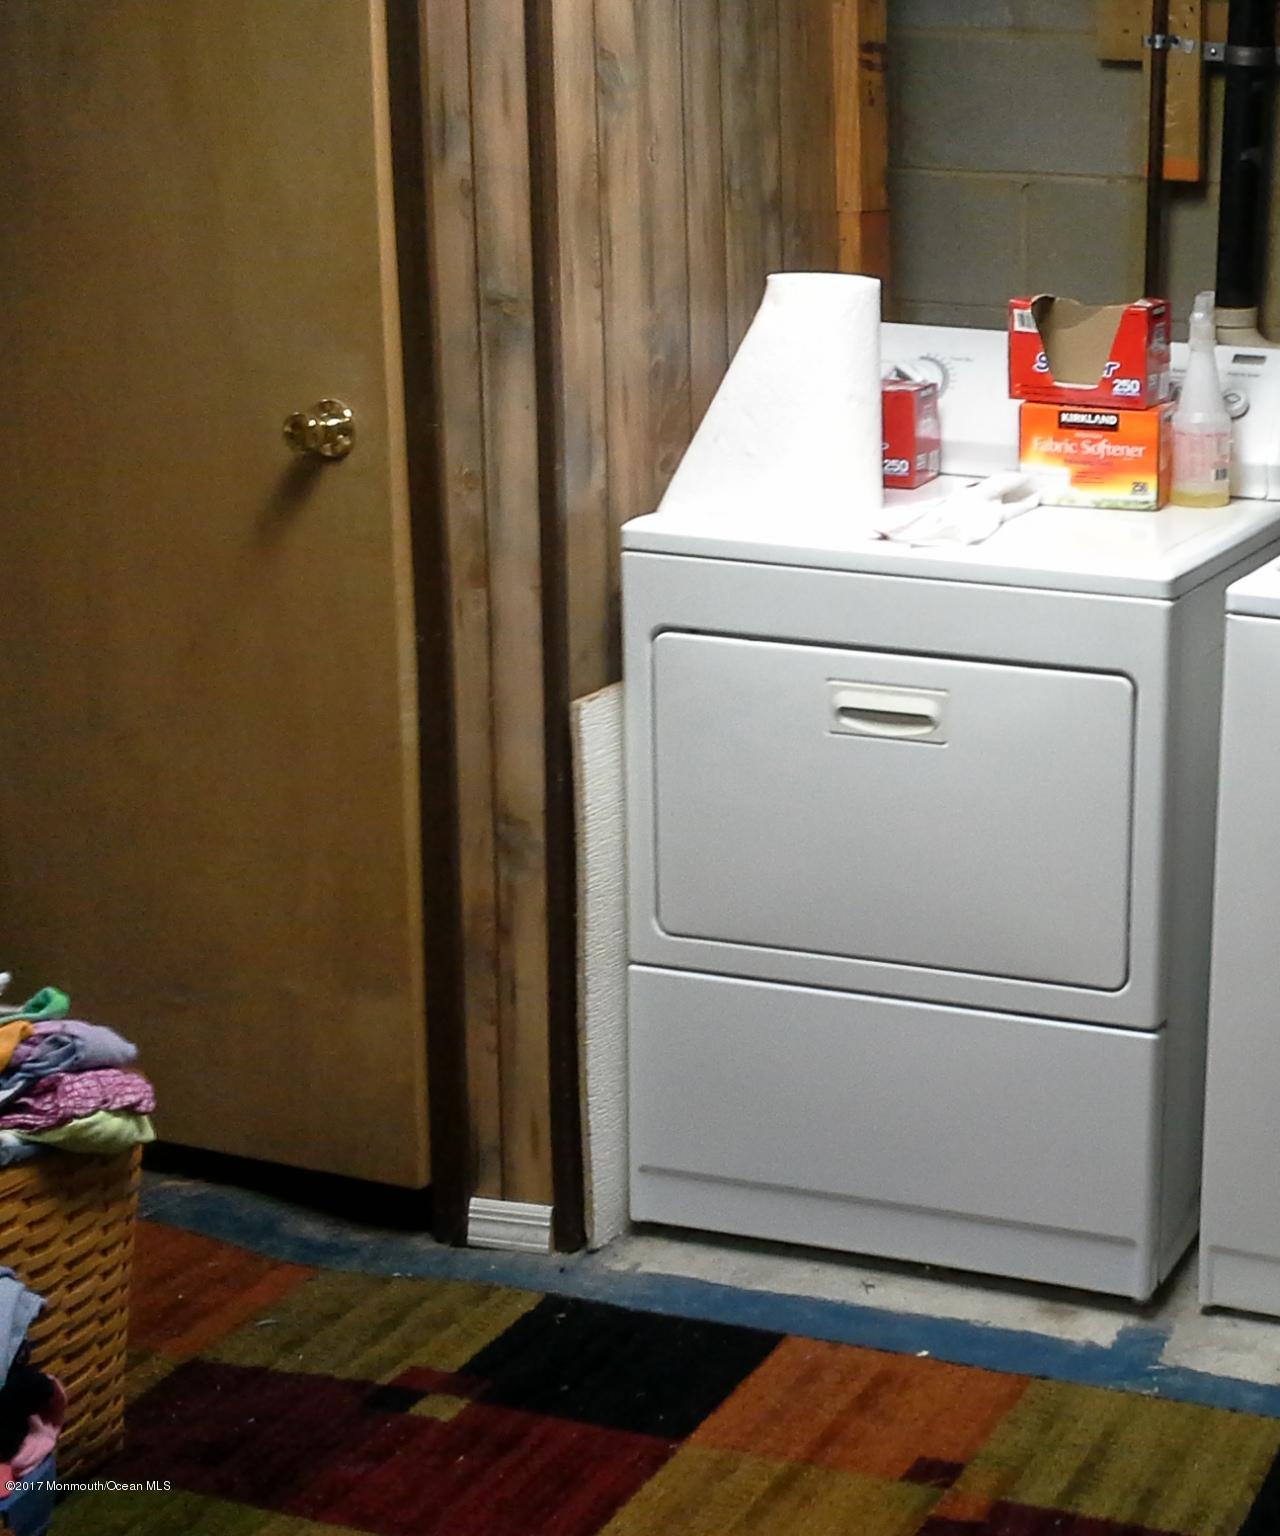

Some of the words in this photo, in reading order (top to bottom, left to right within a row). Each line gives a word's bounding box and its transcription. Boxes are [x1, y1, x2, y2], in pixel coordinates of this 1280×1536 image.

[1112, 380, 1140, 393] 250
[1060, 412, 1118, 426] KIRKLAND
[1033, 436, 1078, 454] Fabric
[1080, 438, 1146, 459] Softener
[882, 458, 909, 473] 250
